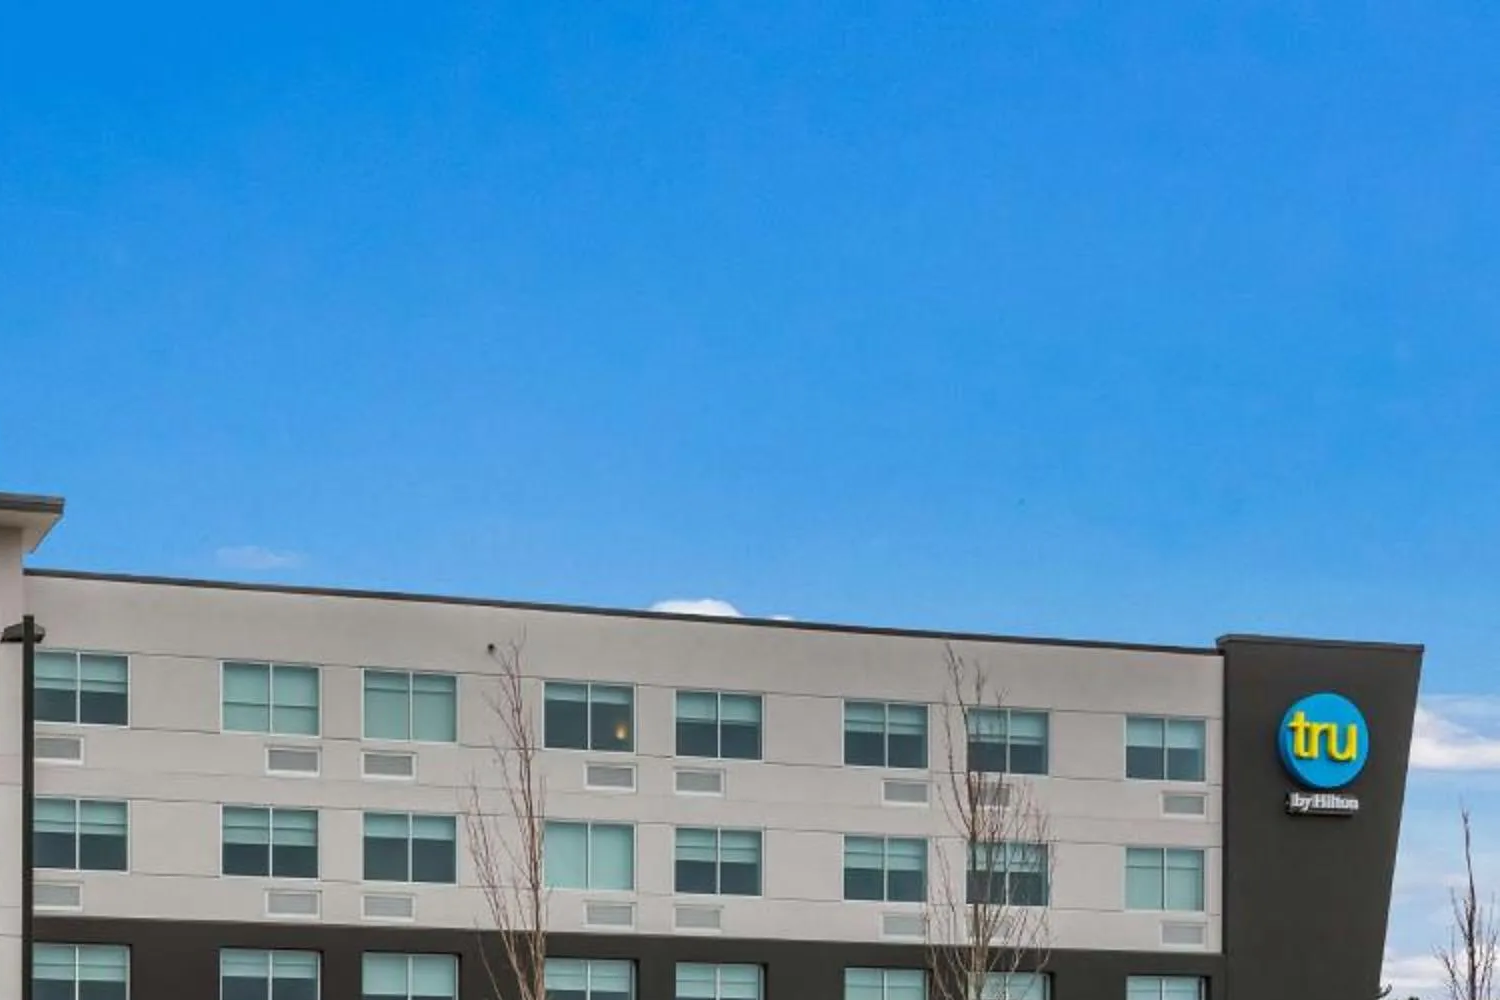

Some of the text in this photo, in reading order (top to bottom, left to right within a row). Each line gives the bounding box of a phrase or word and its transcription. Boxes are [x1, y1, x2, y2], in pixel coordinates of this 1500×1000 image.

[1288, 711, 1357, 761] tru
[1291, 792, 1359, 813] by Hilton
